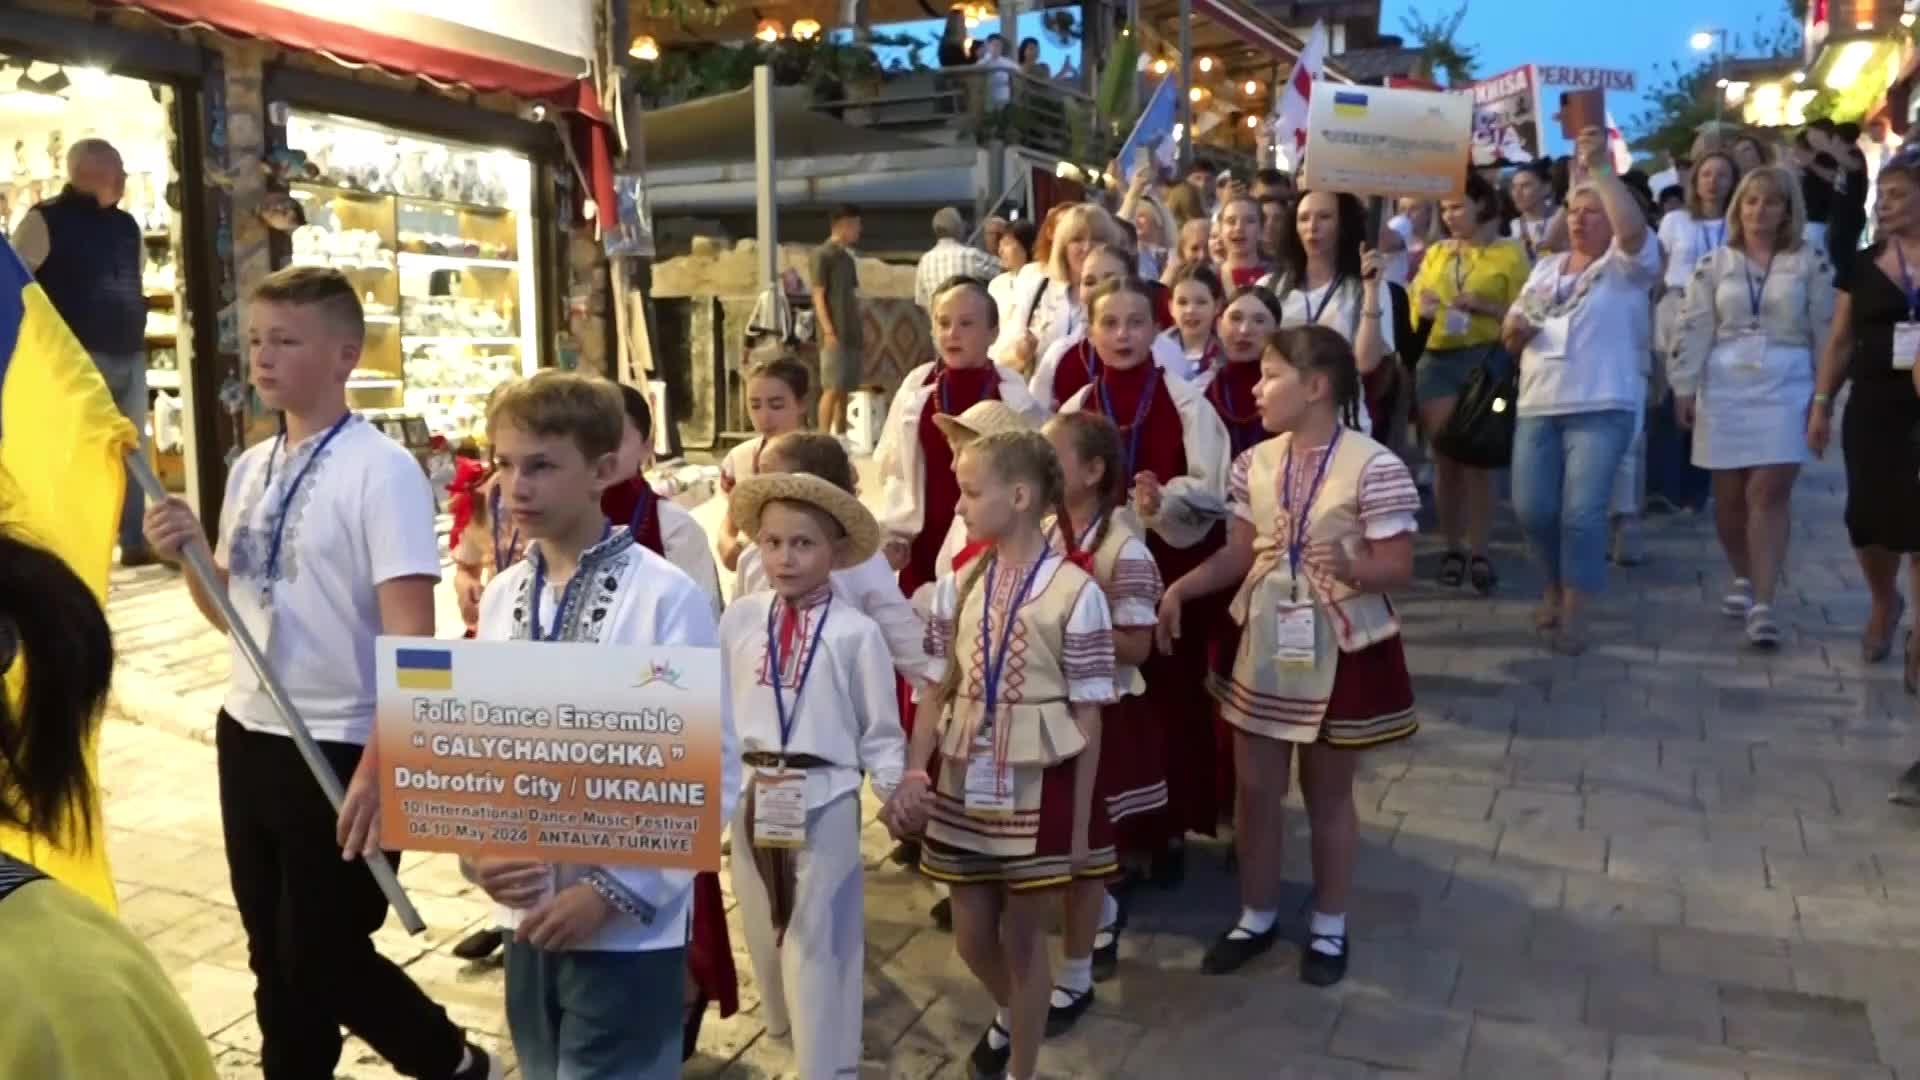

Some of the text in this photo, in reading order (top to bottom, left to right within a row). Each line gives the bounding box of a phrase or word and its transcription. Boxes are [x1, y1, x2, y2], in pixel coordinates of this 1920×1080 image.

[412, 697, 683, 735] Folk Dance Ensemble
[432, 735, 665, 768] GALYCHANOCHKA
[394, 766, 506, 793] Dobrotriv
[513, 773, 562, 802] City
[584, 776, 706, 807] UKRAINE
[455, 825, 485, 841] May
[538, 831, 611, 847] ANTALYA
[528, 809, 577, 824] Dance
[583, 811, 630, 827] Music
[636, 815, 698, 832] Festival
